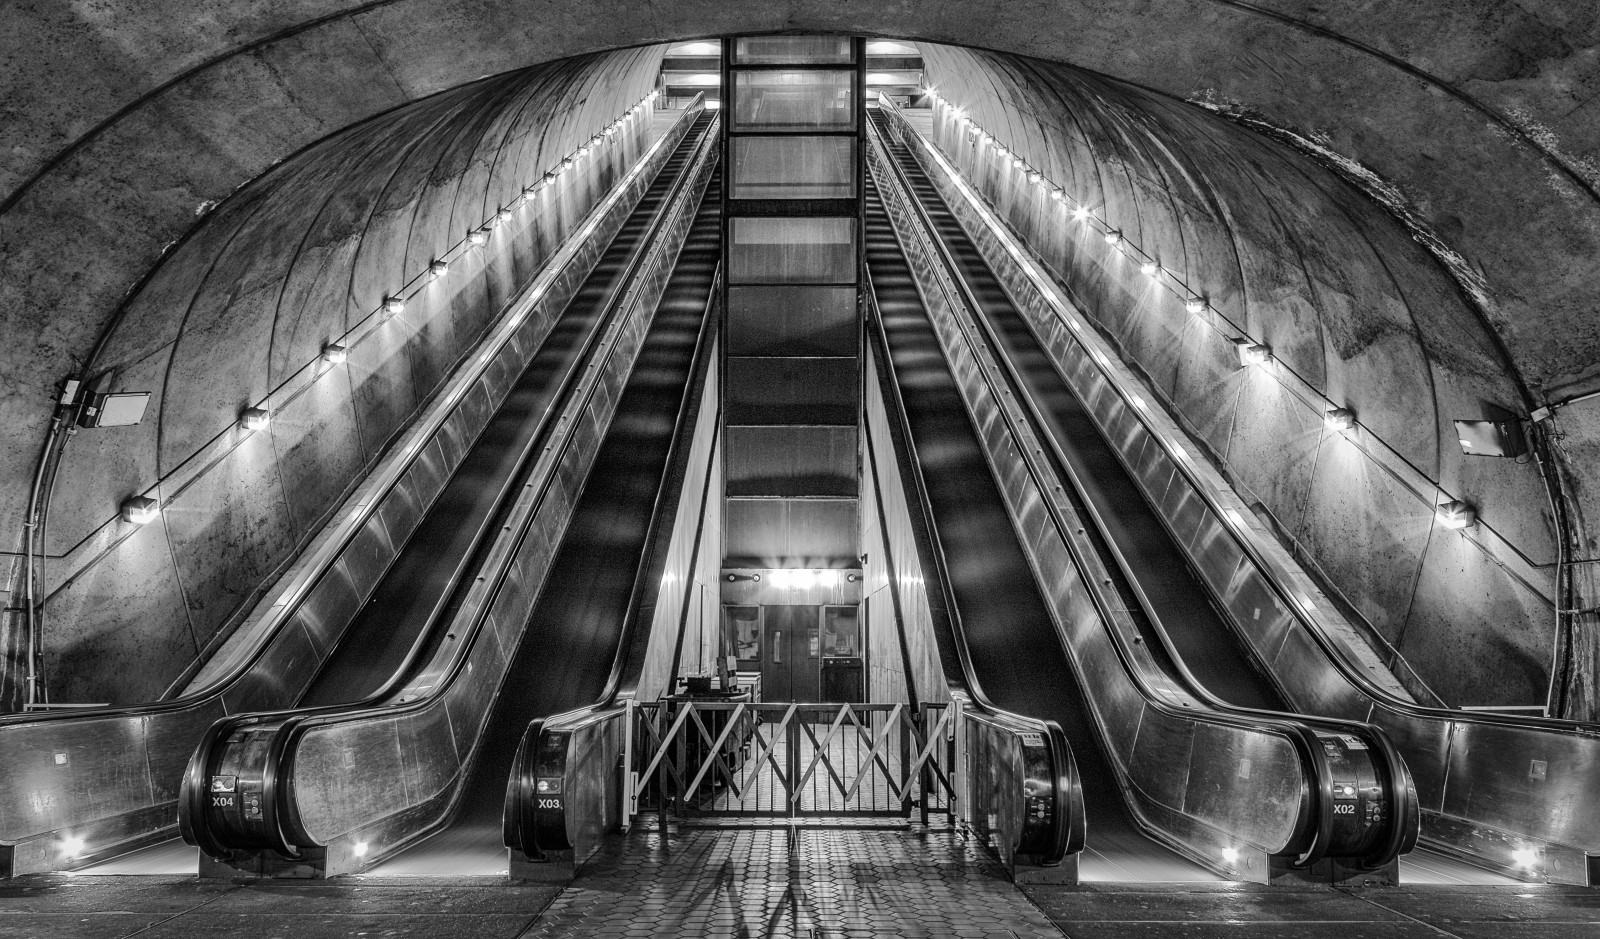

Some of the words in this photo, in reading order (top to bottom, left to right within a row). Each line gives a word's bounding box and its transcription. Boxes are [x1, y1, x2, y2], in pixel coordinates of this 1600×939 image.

[212, 797, 233, 806] X04
[538, 799, 560, 808] X03
[1333, 804, 1355, 814] X02
